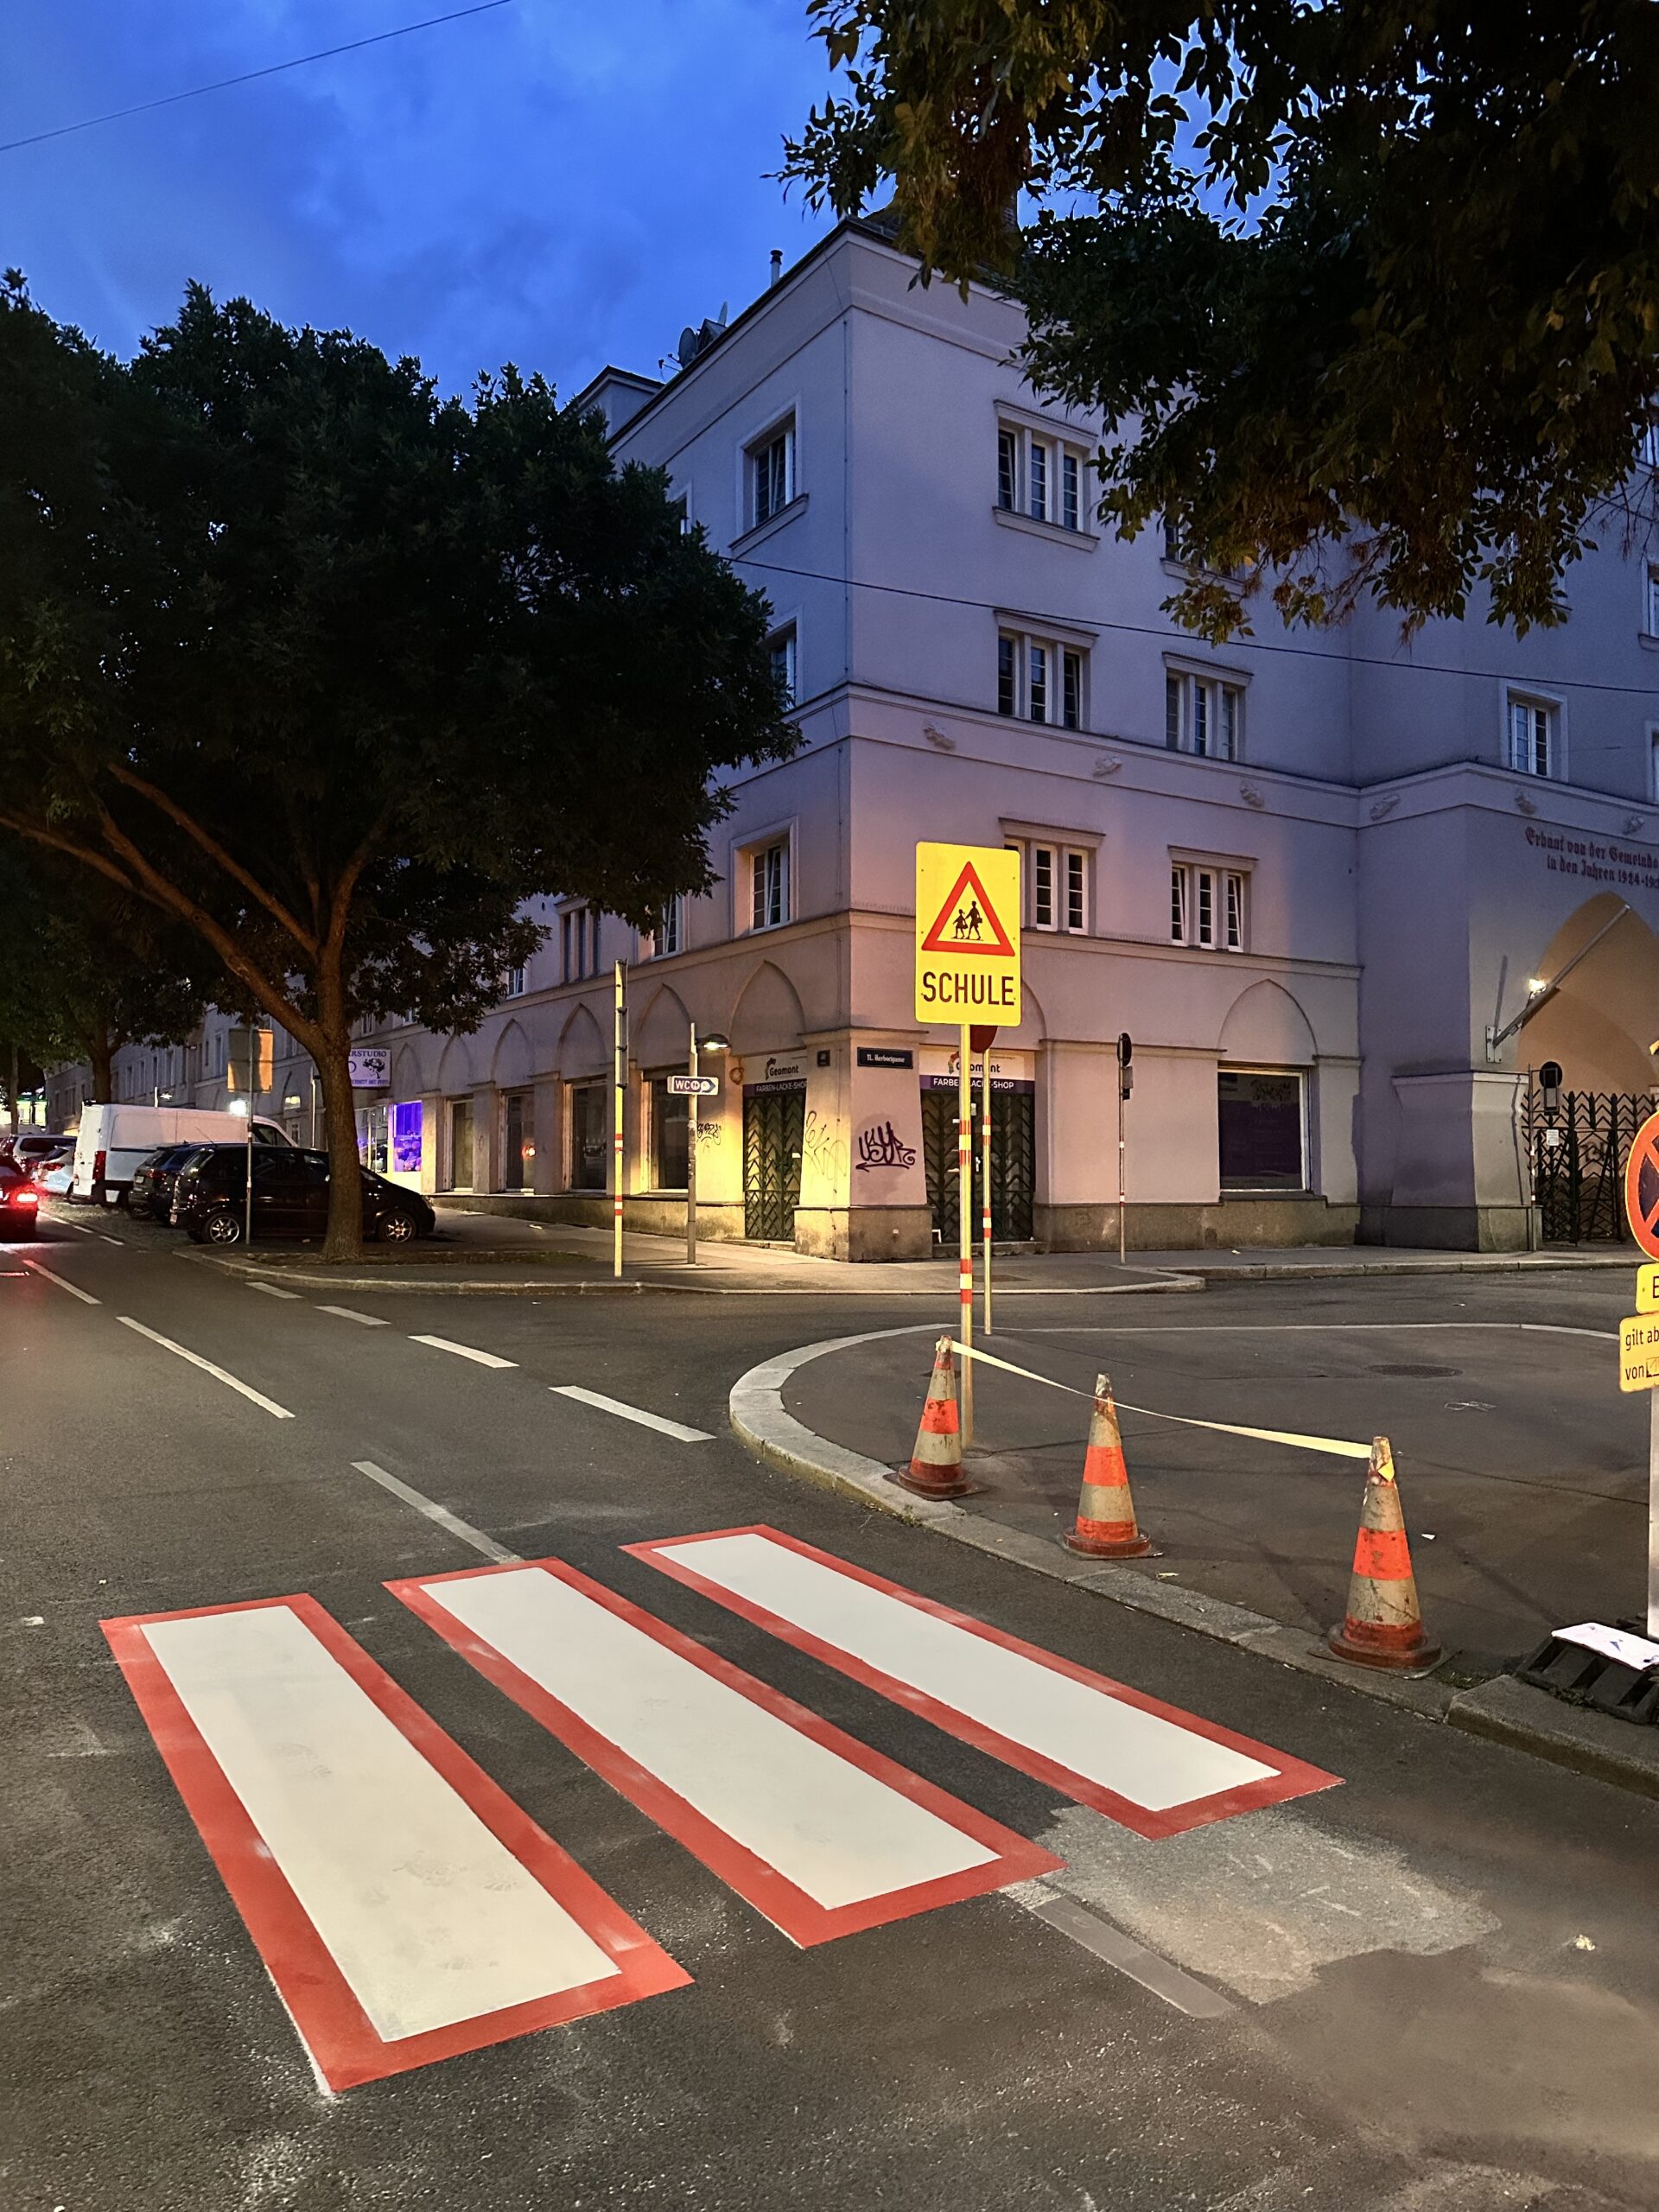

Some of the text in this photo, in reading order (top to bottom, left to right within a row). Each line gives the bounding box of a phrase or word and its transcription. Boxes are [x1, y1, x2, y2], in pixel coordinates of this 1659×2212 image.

[1567, 842, 1586, 855] von
[1589, 842, 1606, 860] der
[1547, 855, 1557, 870] in
[1560, 855, 1578, 874] den
[1581, 859, 1615, 881] Jahren
[923, 971, 1014, 1006] SCHULE
[769, 1065, 799, 1077] Geomont
[675, 1080, 690, 1090] WC
[1625, 1328, 1644, 1351] gilt
[1625, 1364, 1644, 1381] von
